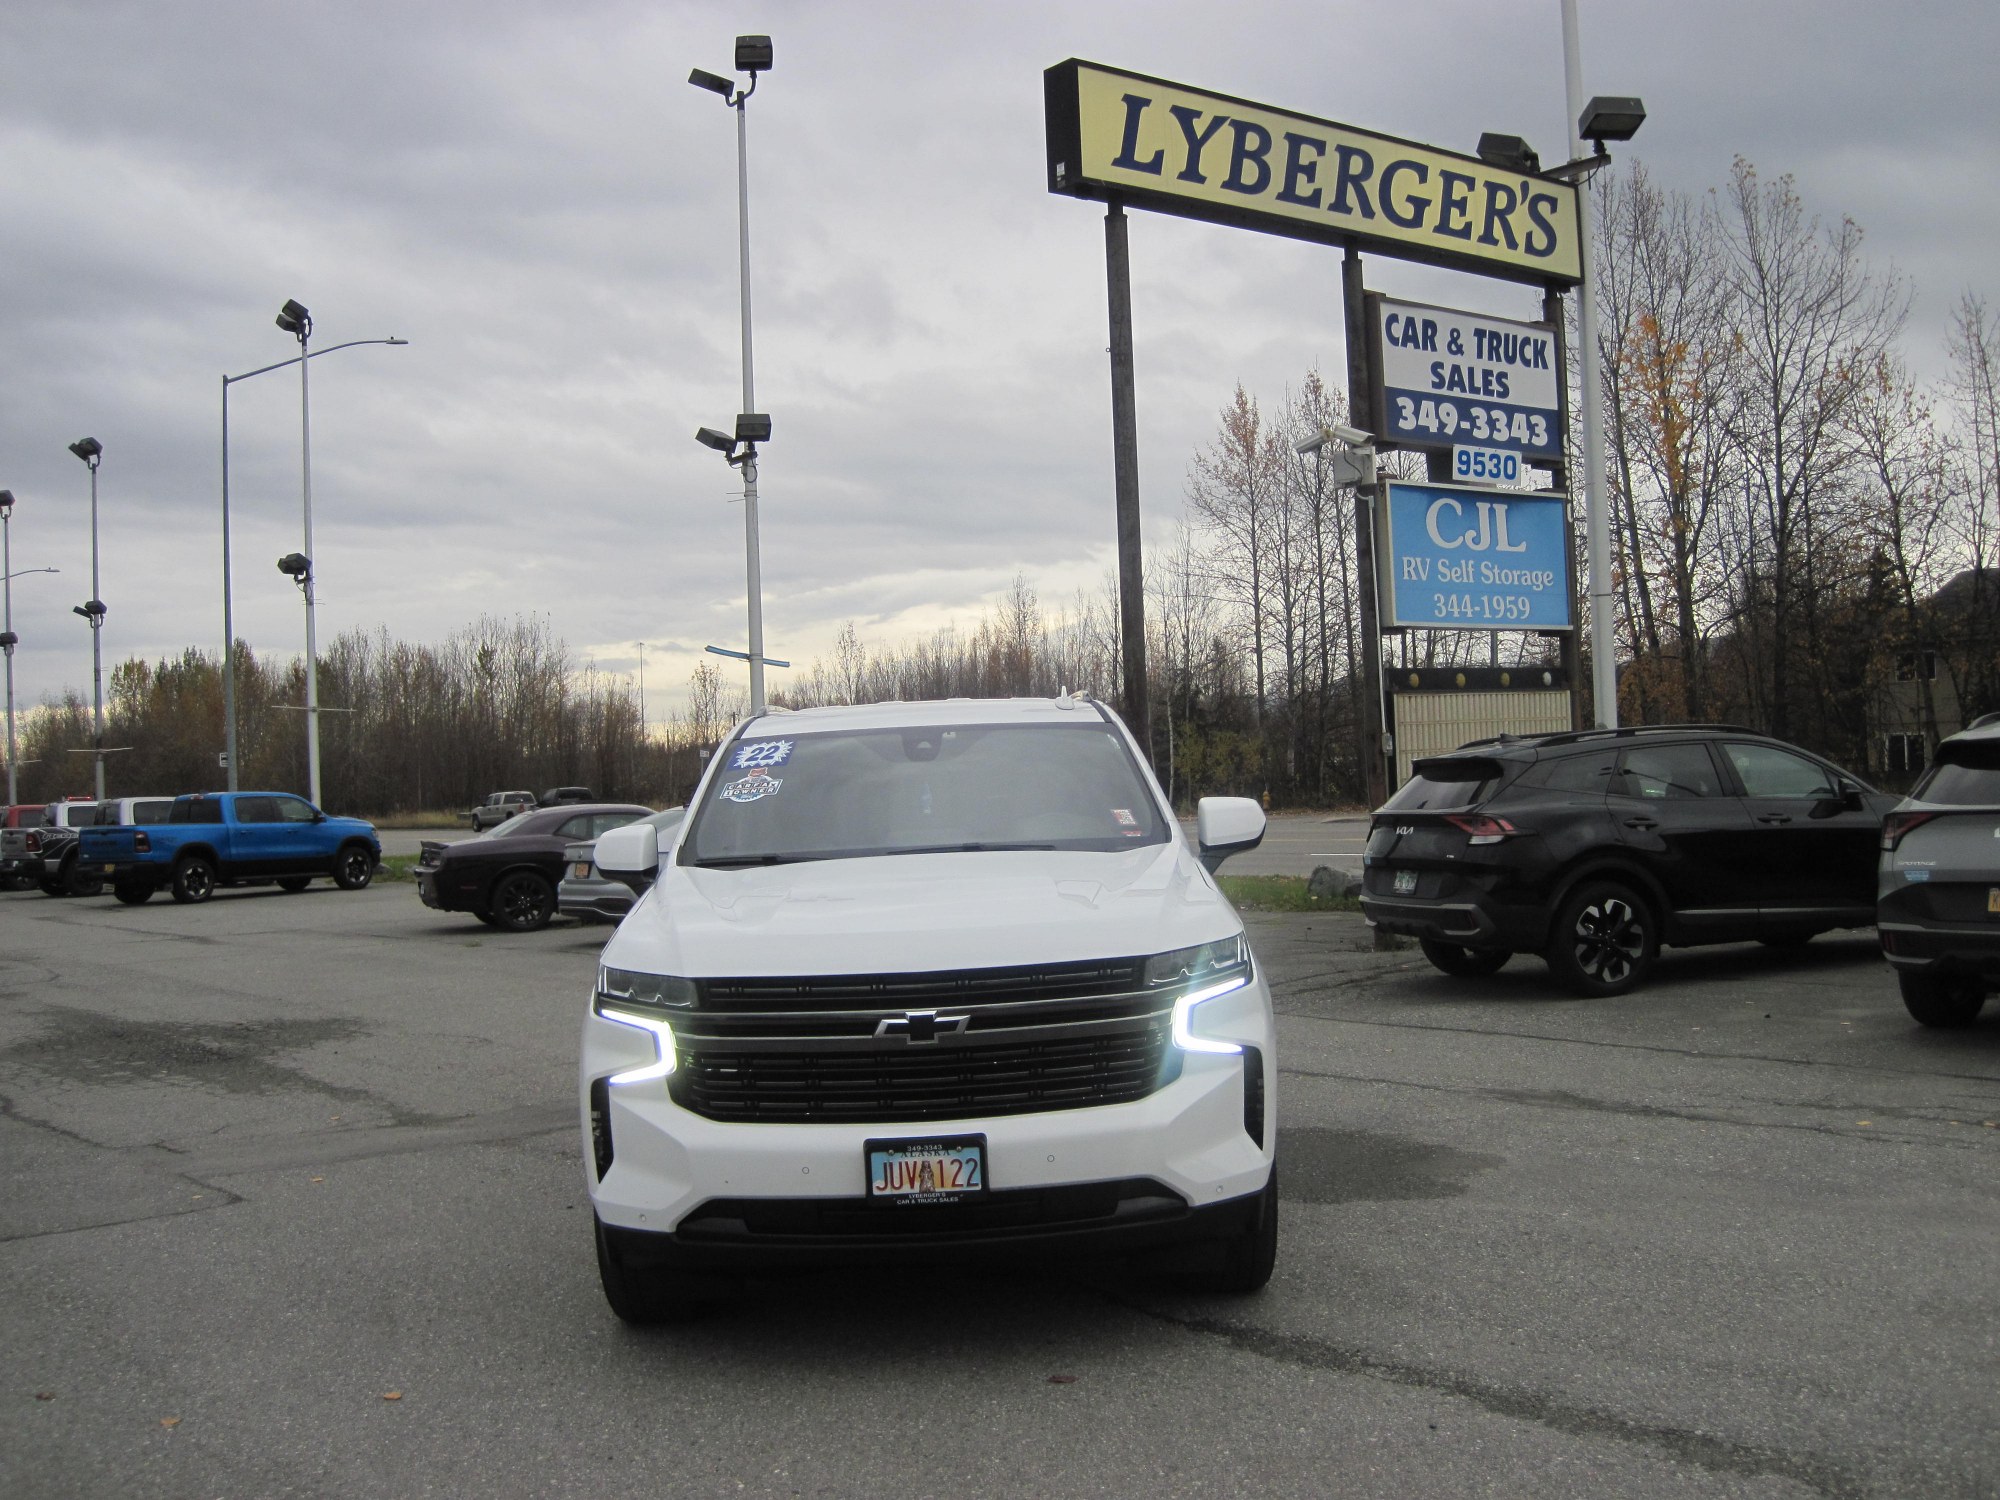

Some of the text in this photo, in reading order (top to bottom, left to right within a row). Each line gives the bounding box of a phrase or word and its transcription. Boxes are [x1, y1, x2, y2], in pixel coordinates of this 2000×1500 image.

[1111, 93, 1559, 258] LYBERGER'S
[1385, 312, 1549, 370] CAR & TRUCK
[1430, 361, 1510, 399] SALES
[1396, 396, 1548, 446] 349-3343
[1456, 450, 1518, 481] 9530
[1425, 497, 1527, 552] CJL
[1402, 556, 1554, 591] RV Self Storage
[1434, 593, 1530, 620] 344-1959
[744, 745, 781, 763] 22
[728, 781, 779, 790] CARFAX
[733, 787, 775, 795] OWNER
[900, 1150, 951, 1158] ALASKA
[876, 1158, 979, 1191] JUV 122
